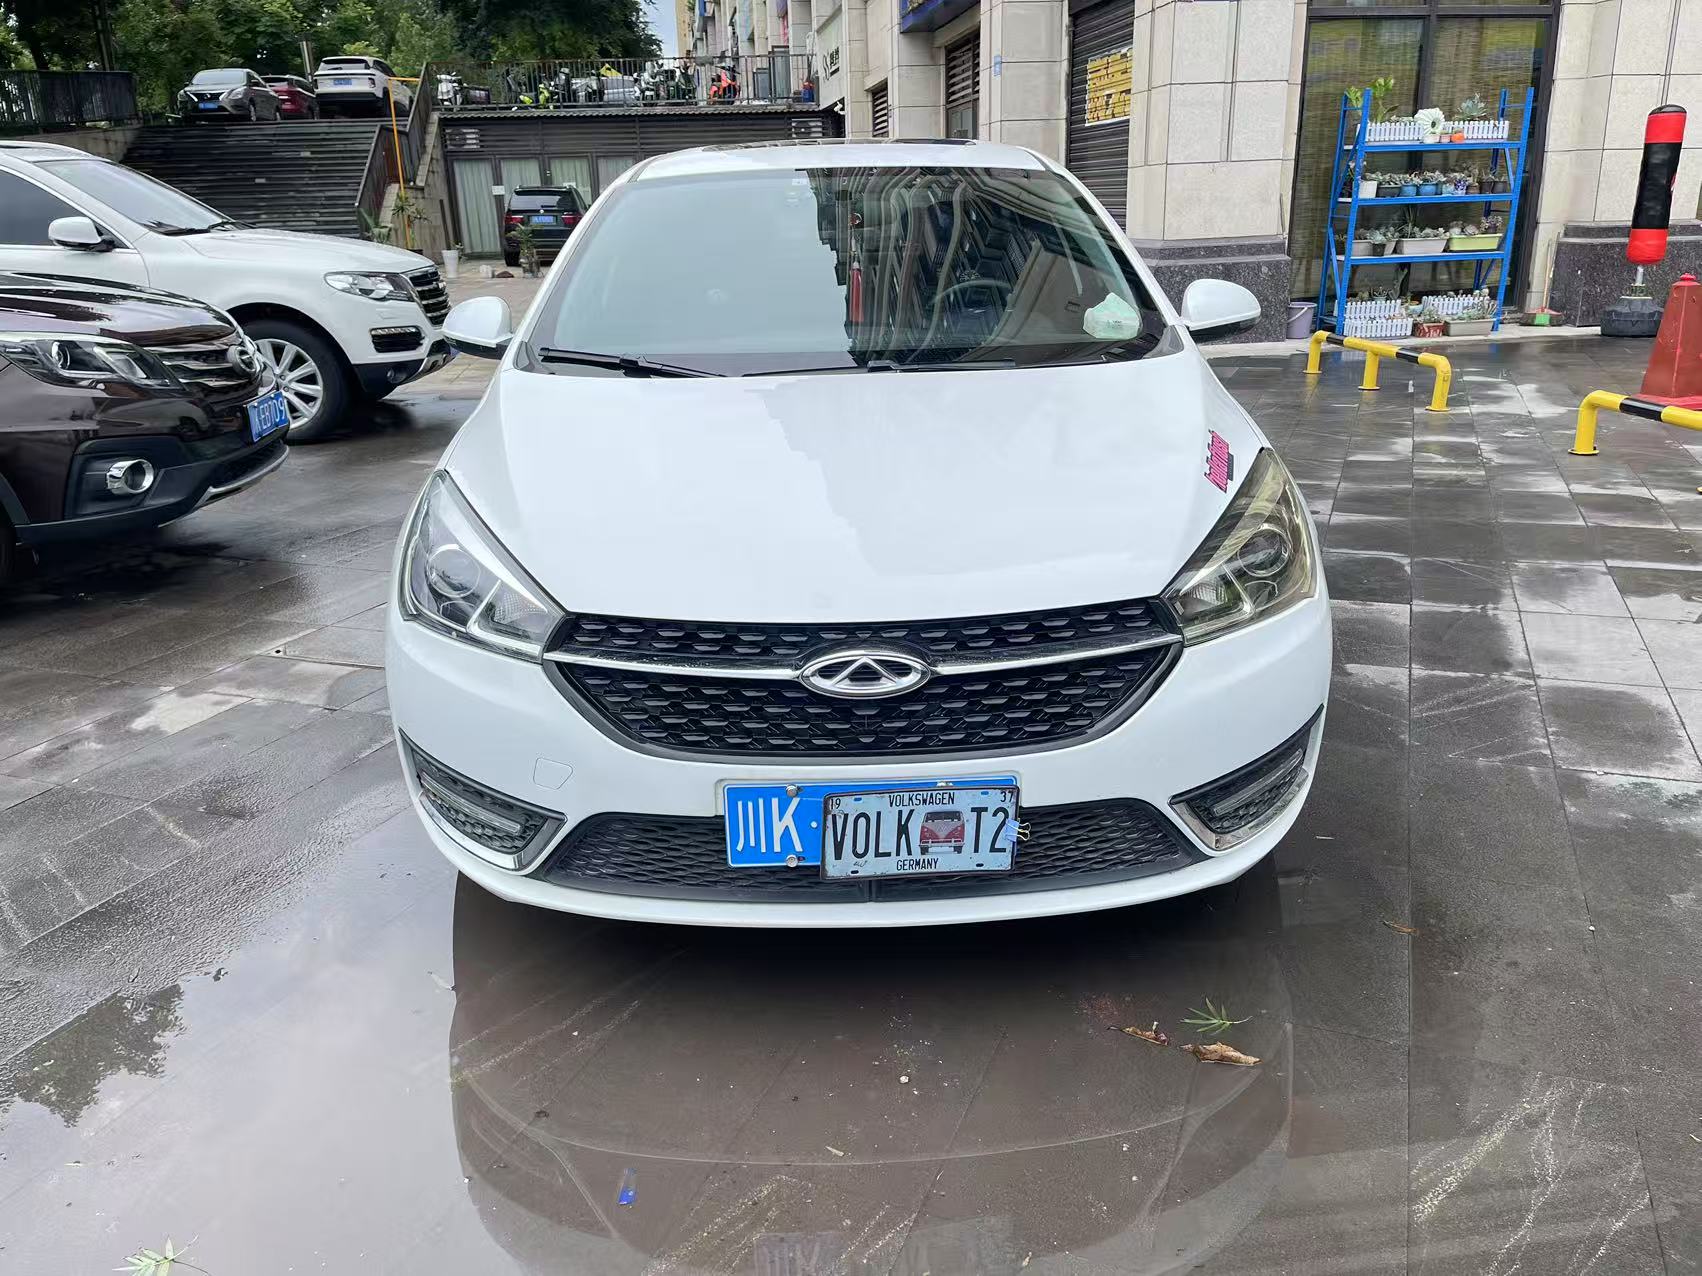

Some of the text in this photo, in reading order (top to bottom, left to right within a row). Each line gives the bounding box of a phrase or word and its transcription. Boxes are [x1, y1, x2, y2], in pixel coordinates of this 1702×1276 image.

[830, 798, 841, 810] 19
[888, 792, 955, 808] VOLKSWAGEN
[1000, 791, 1014, 803] 37
[831, 806, 1010, 861] VOLK T2
[896, 857, 939, 872] GERMANY
